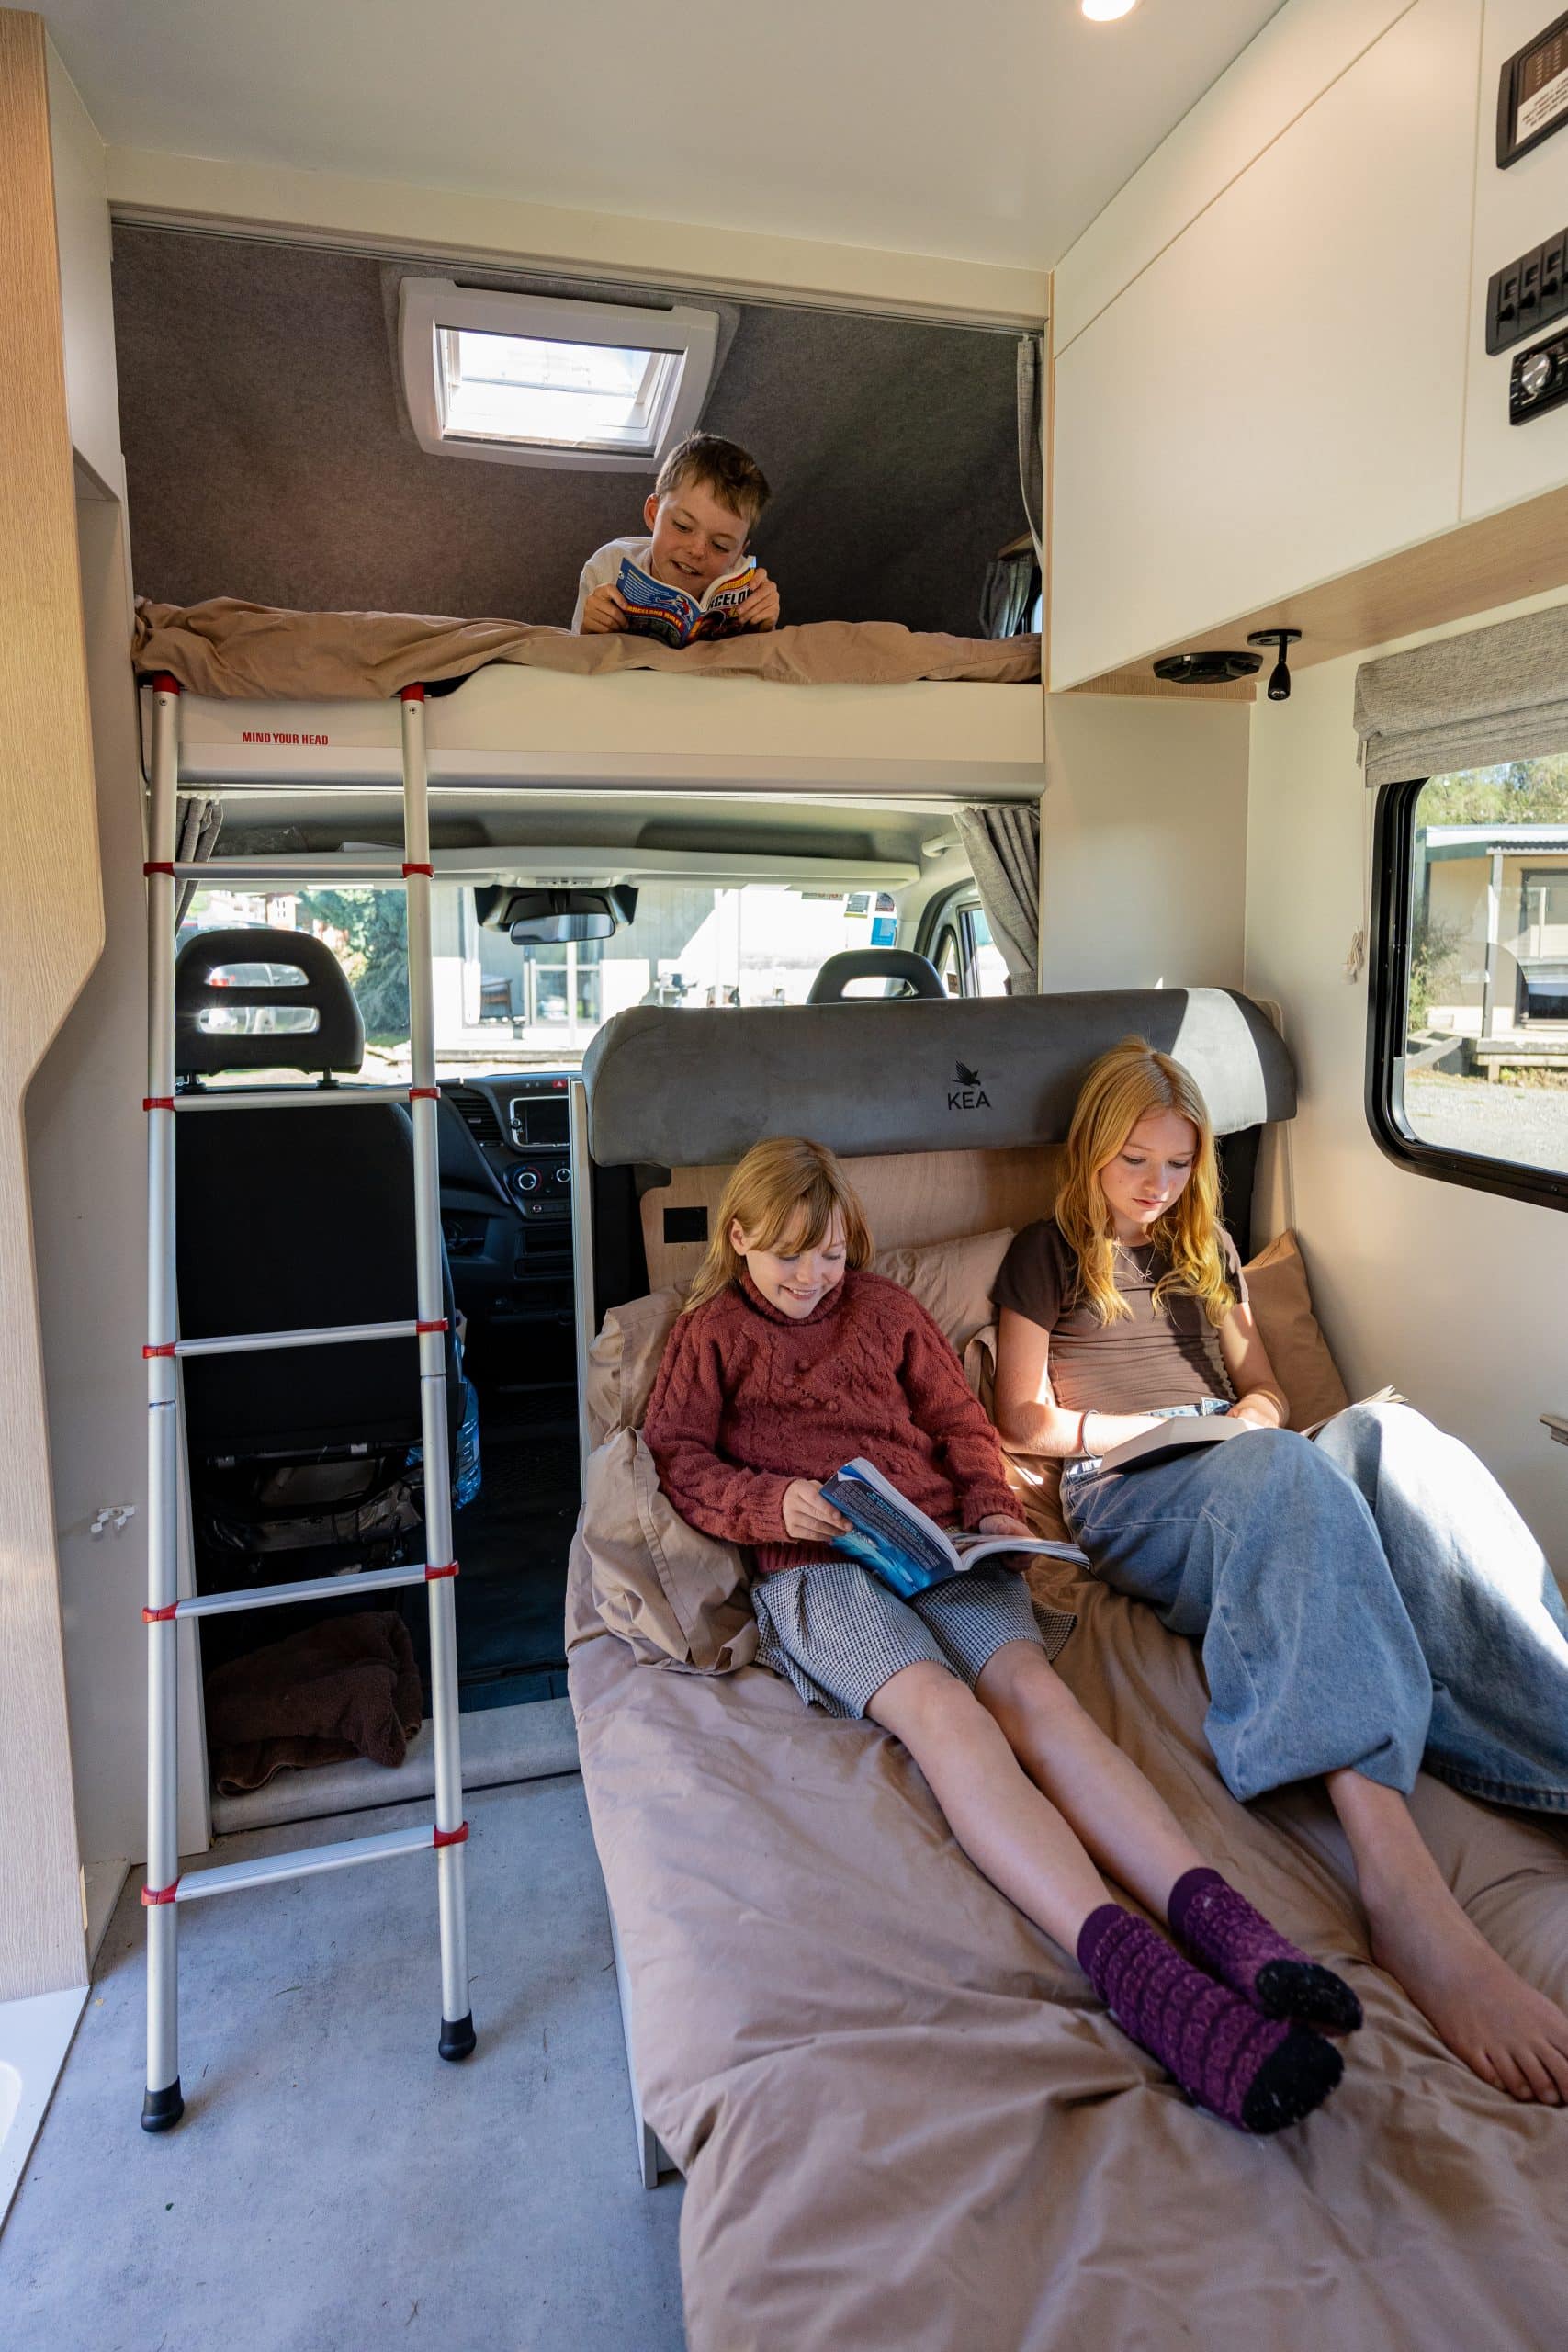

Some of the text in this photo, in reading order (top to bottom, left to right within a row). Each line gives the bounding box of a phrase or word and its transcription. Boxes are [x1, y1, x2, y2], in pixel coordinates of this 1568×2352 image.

[626, 605, 663, 617] ARCELONA
[242, 731, 329, 745] MIND YOUR HEAD
[947, 1091, 991, 1111] KEA
